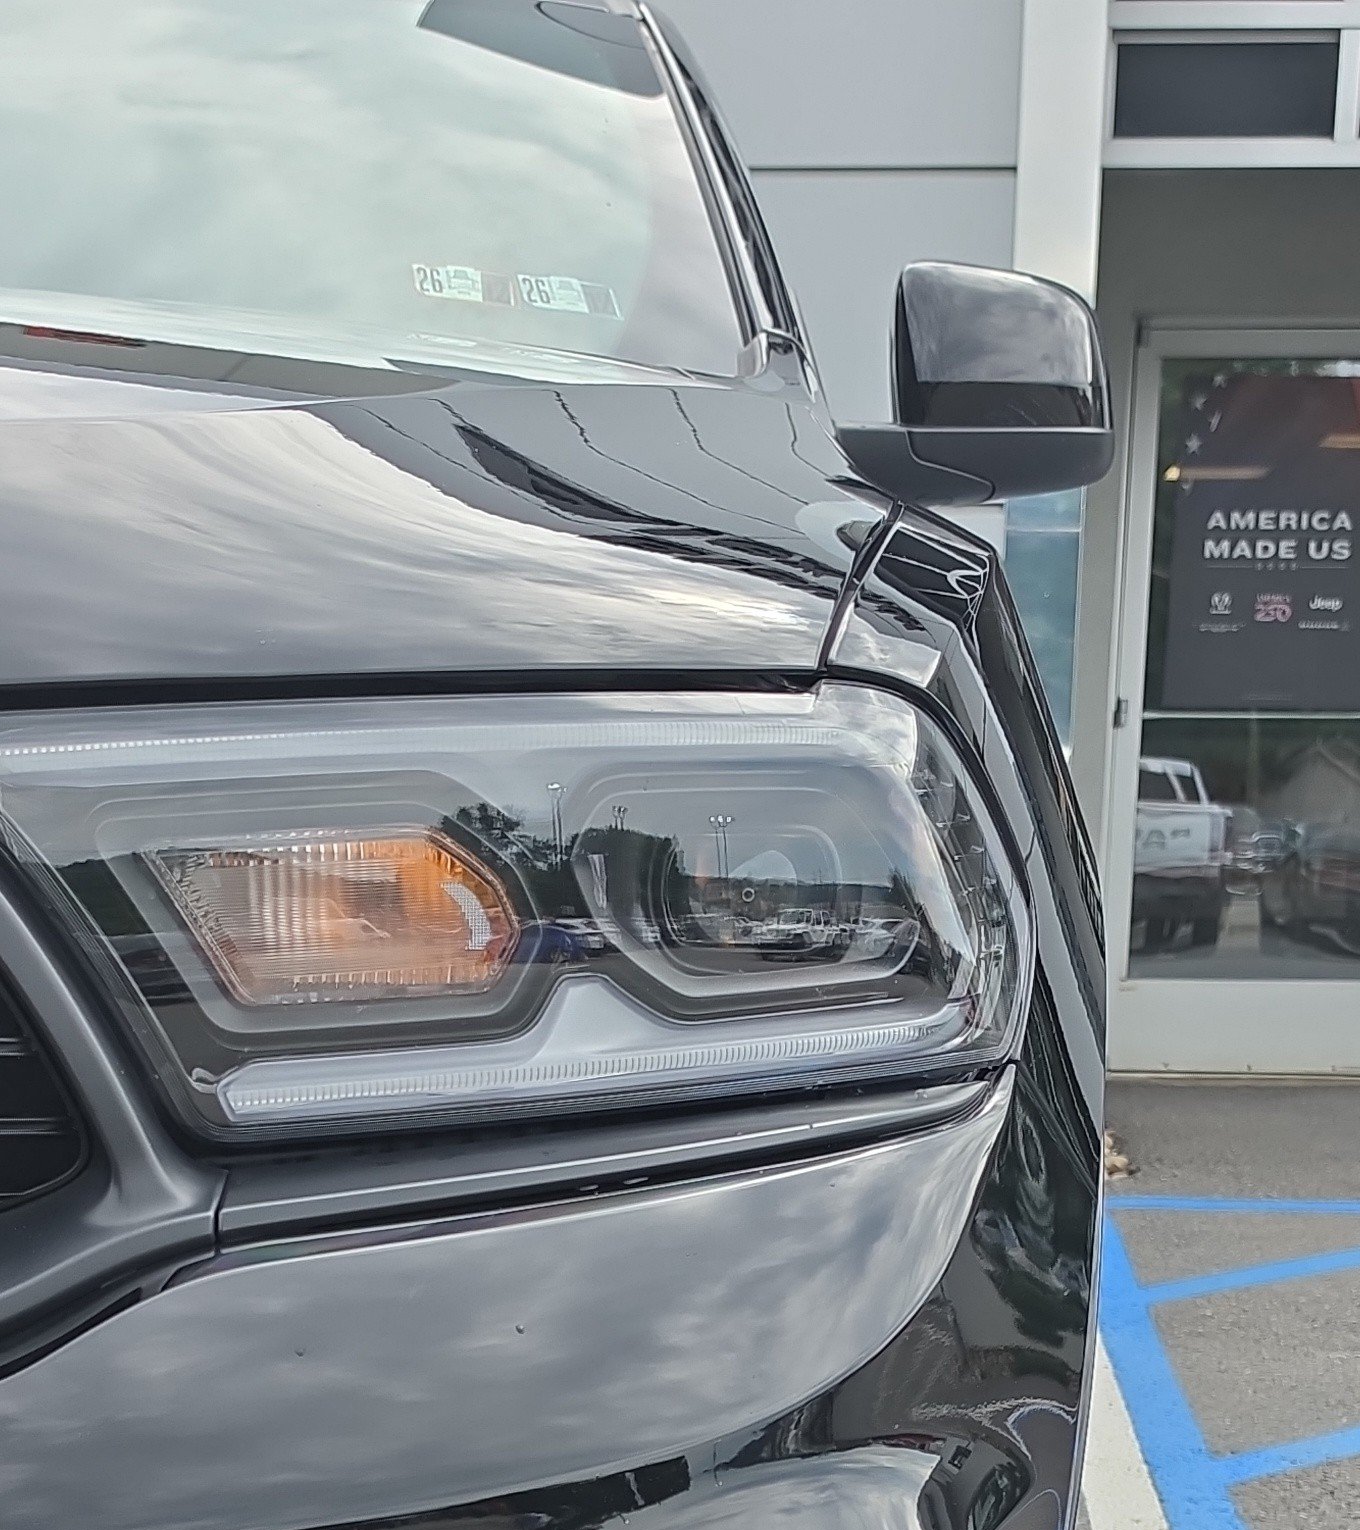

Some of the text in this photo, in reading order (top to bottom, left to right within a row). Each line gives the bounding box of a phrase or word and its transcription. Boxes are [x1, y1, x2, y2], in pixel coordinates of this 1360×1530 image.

[416, 266, 444, 293] 26
[522, 277, 551, 304] 26
[1206, 509, 1353, 531] AMERICA
[1203, 538, 1352, 561] MADE US
